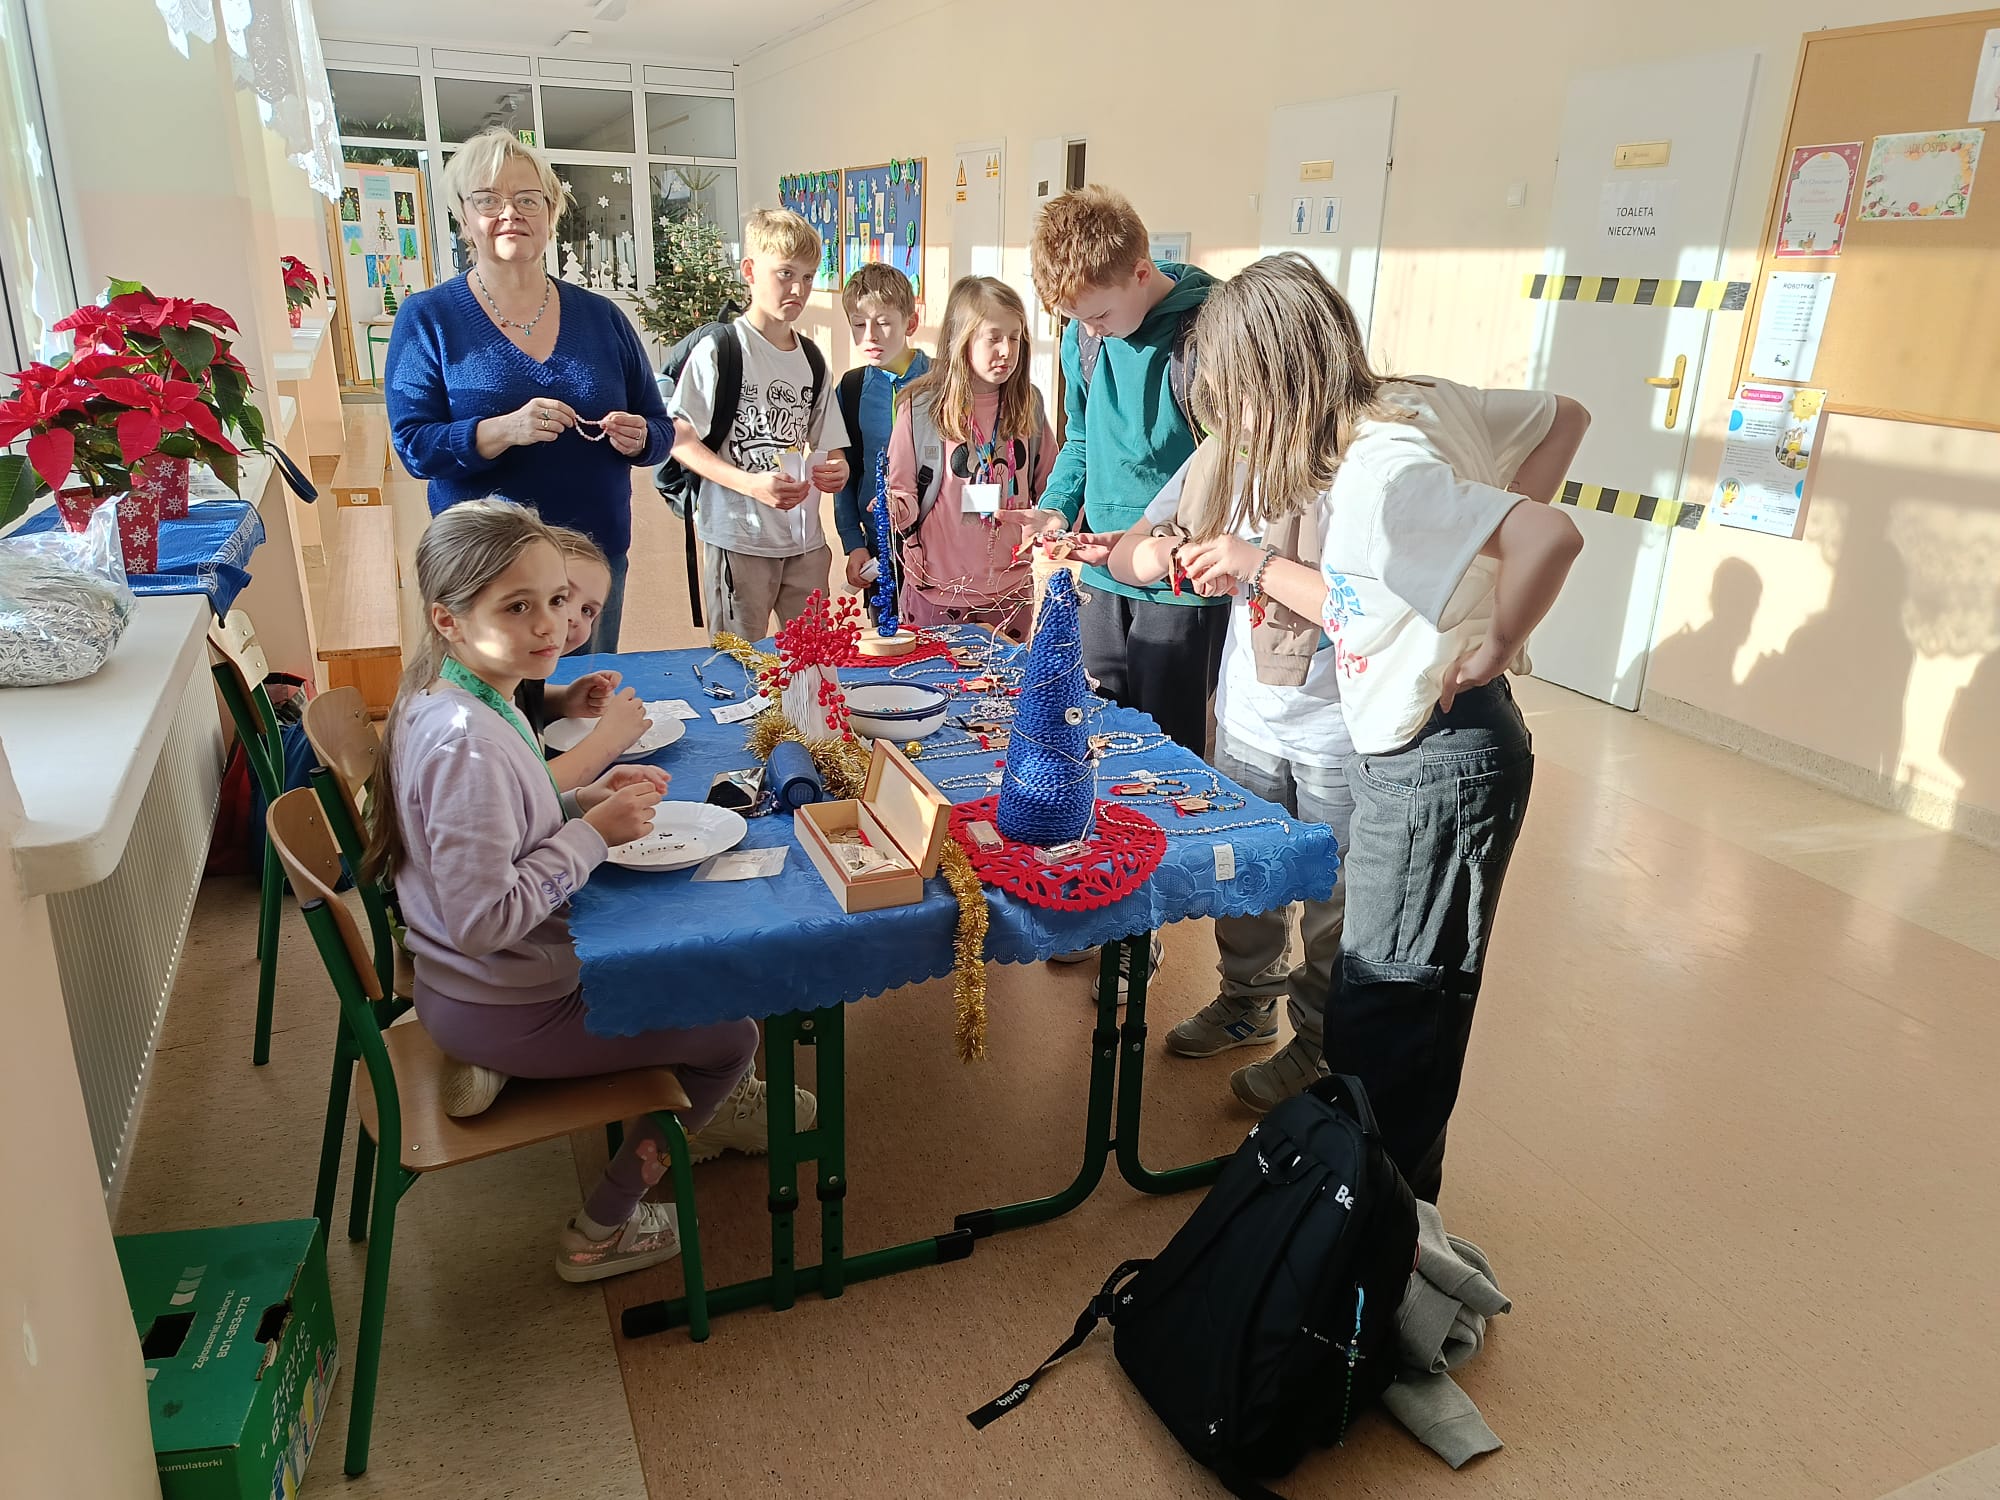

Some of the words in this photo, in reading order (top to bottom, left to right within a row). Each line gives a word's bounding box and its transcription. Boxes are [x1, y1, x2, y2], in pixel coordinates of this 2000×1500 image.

[1616, 207, 1654, 217] TOALETA
[1607, 226, 1656, 236] NIECZYNNA
[216, 1296, 250, 1359] 801-363-373
[158, 1458, 223, 1473] kumulatorki
